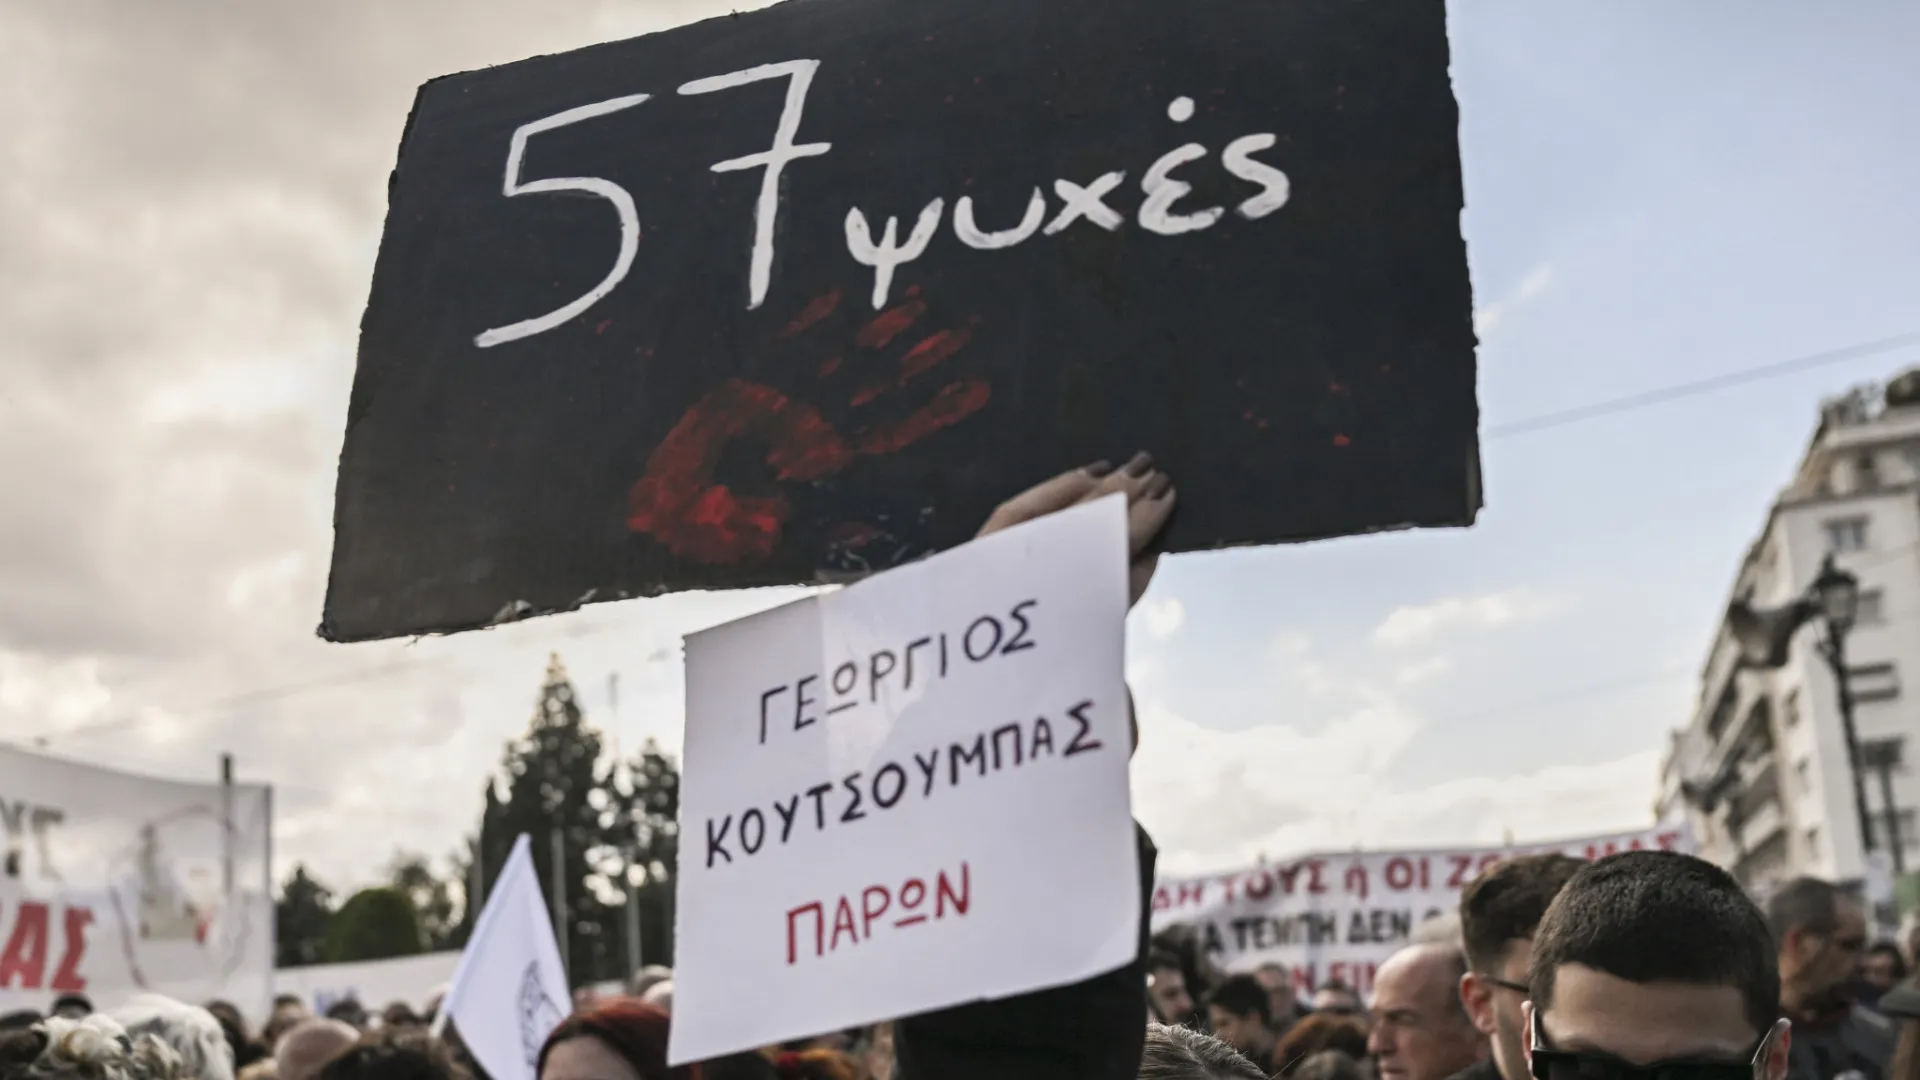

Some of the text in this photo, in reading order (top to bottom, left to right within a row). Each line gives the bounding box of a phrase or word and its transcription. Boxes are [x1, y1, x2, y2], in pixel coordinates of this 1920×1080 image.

[475, 58, 1290, 347] 57 ψυχές
[760, 599, 1038, 745] ΓΕΩΡΓΙΟΣ
[705, 699, 1104, 869] ΚΟΥΤΣΟΥΜΠΑΣ
[786, 862, 970, 966] ΠΑΡΩΝ
[1151, 884, 1202, 909] ΔΗ
[1384, 856, 1430, 891] ΟΙ
[1347, 909, 1412, 943] ΔΕΝ
[0, 901, 95, 990] ΑΣ
